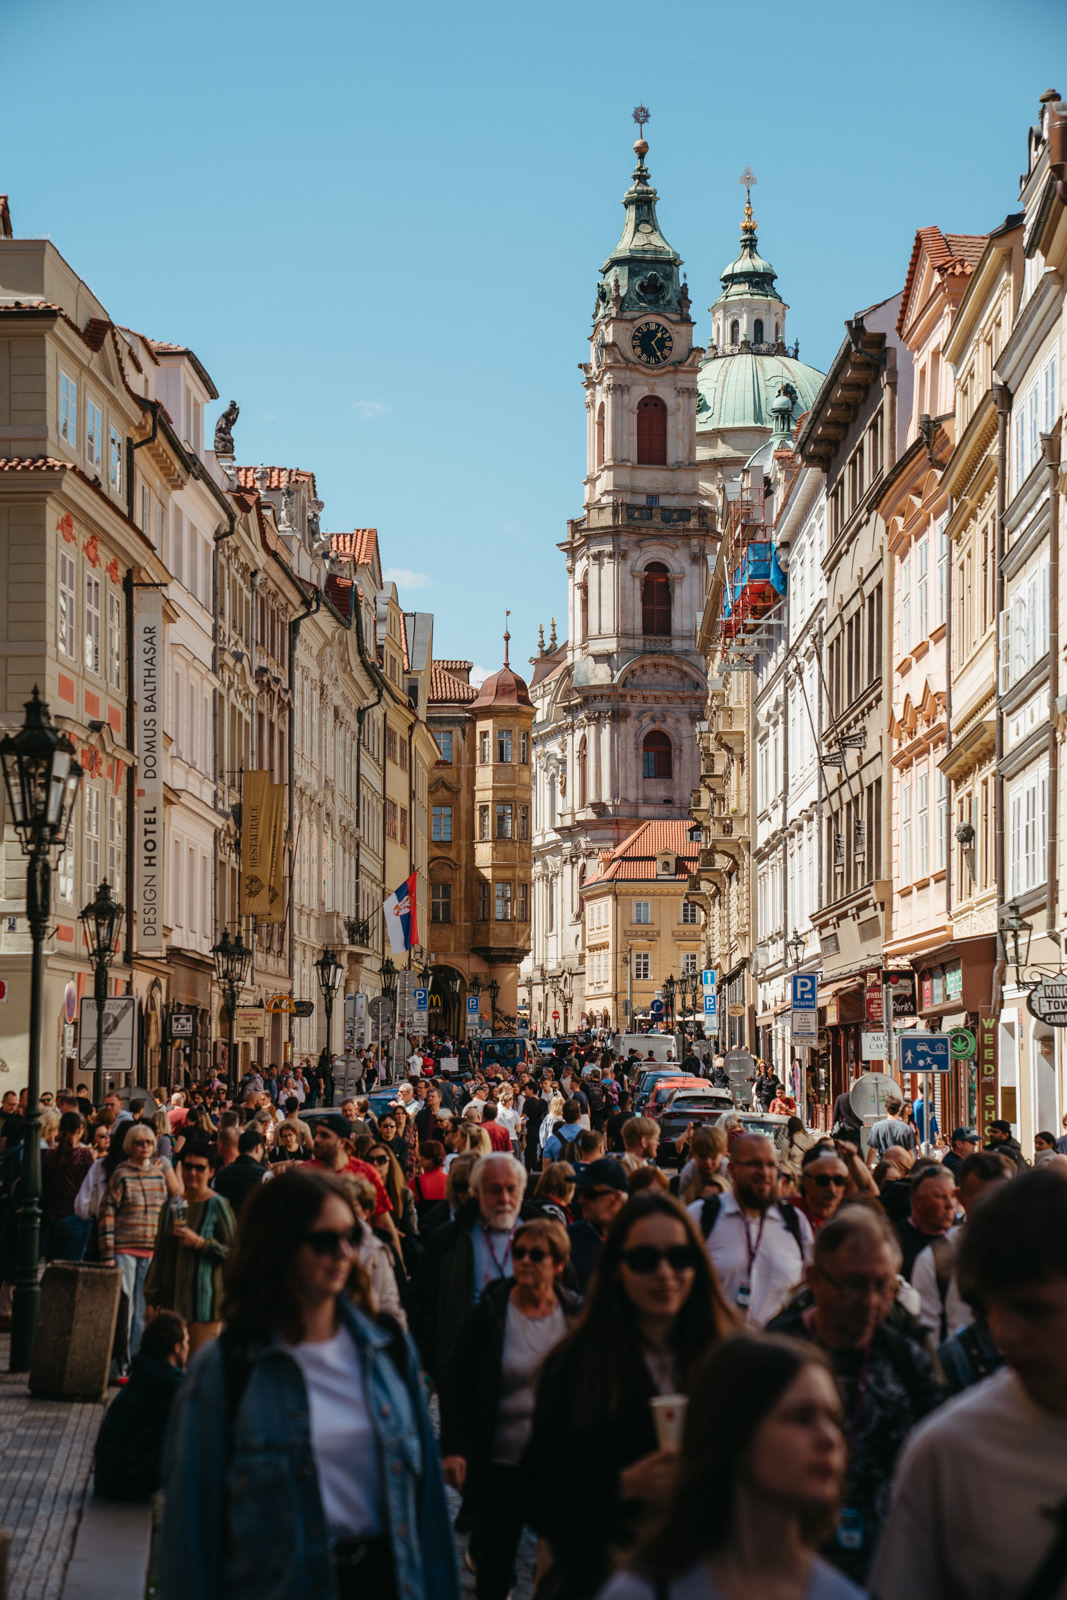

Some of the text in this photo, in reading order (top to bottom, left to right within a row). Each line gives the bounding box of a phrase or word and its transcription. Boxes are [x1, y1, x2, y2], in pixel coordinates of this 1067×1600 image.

[143, 625, 157, 936] DESIGN HOTEL DOMUS BALTHASAR
[249, 805, 259, 868] RESTAURACE
[416, 991, 424, 1002] P
[797, 978, 812, 999] P
[469, 999, 476, 1008] P
[706, 997, 714, 1009] P
[981, 1018, 996, 1075] WEED
